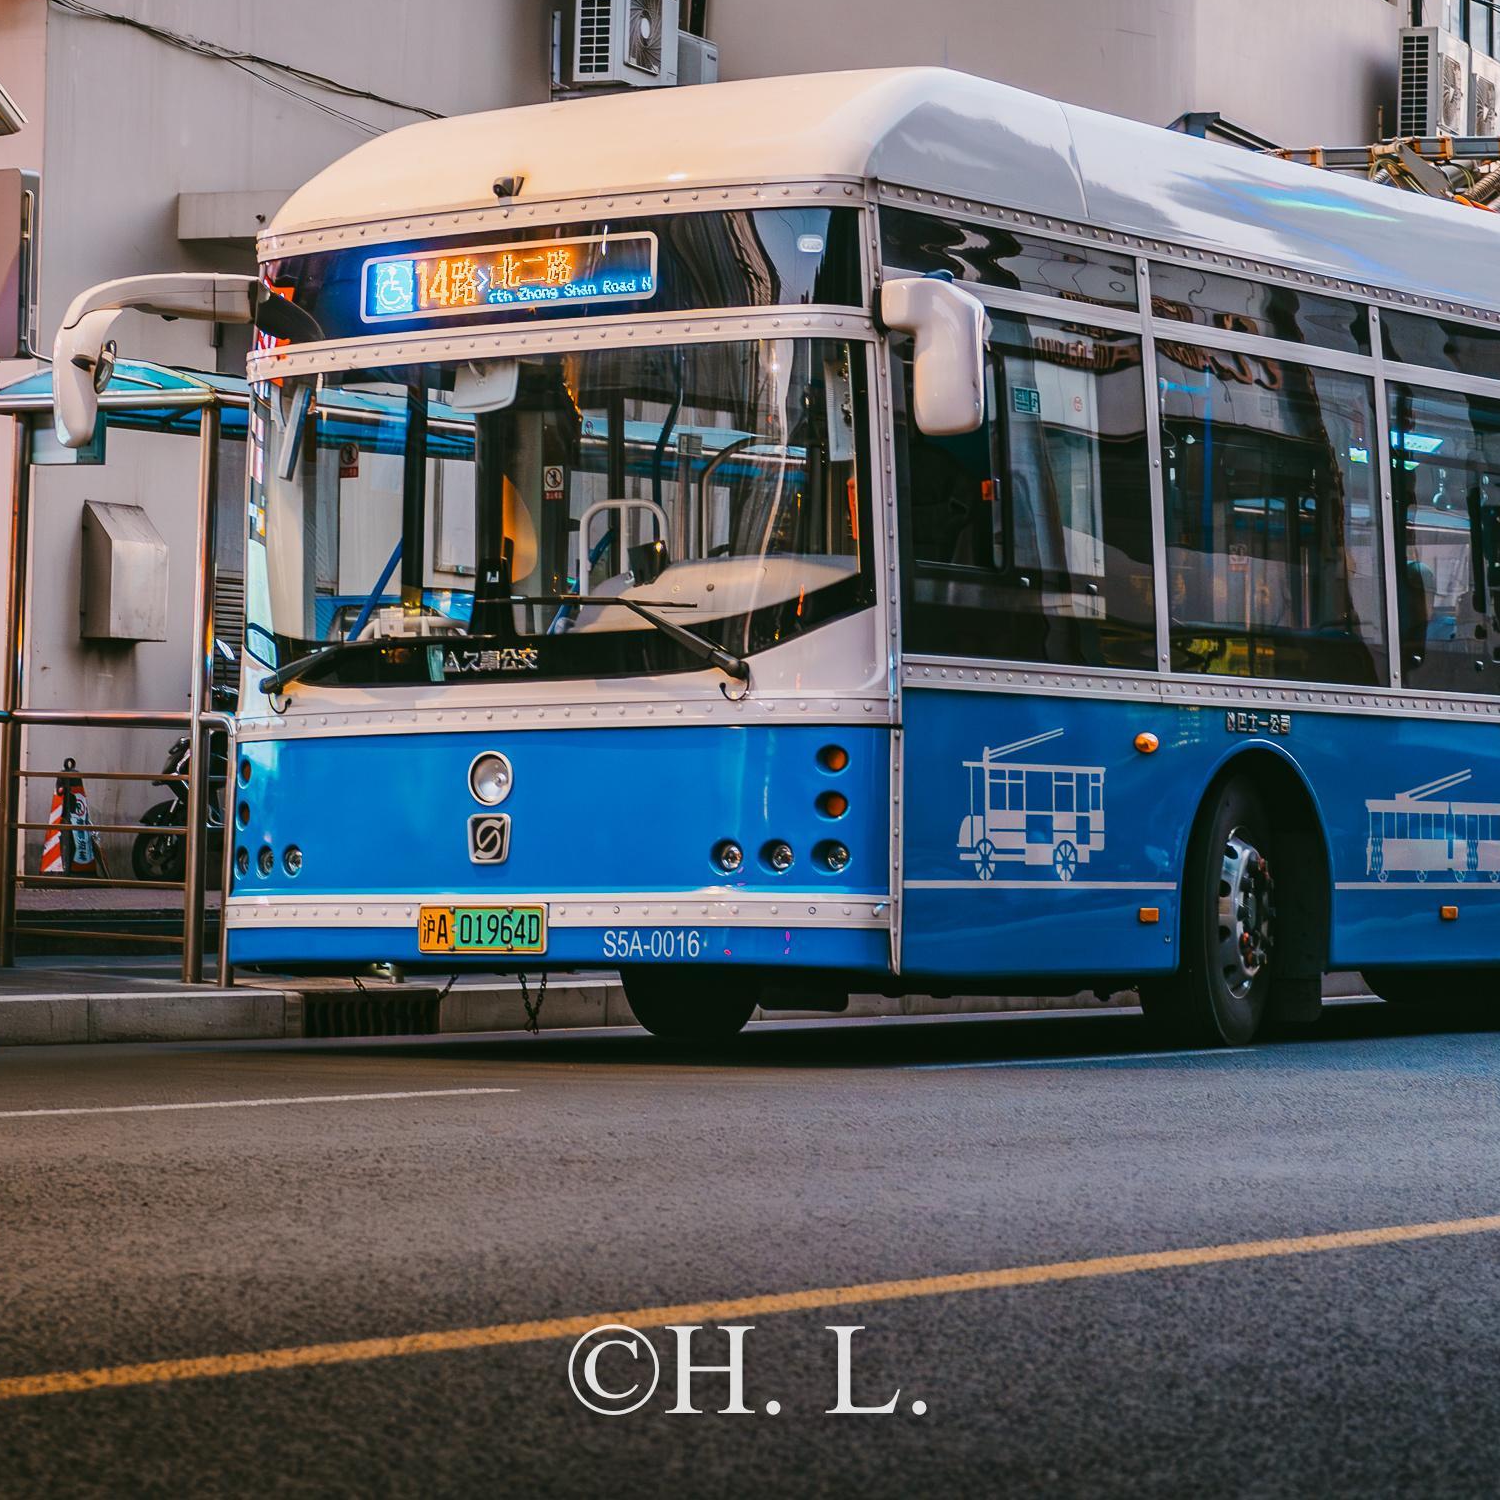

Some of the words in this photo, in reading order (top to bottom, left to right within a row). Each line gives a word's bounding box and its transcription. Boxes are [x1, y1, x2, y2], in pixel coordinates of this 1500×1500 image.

[415, 258, 478, 307] 14路
[489, 250, 573, 289] 北二路
[564, 283, 597, 298] Shan
[603, 279, 636, 294] Road
[422, 913, 448, 945] 沪A
[459, 913, 540, 945] 01964D
[602, 930, 700, 958] S5A-0016
